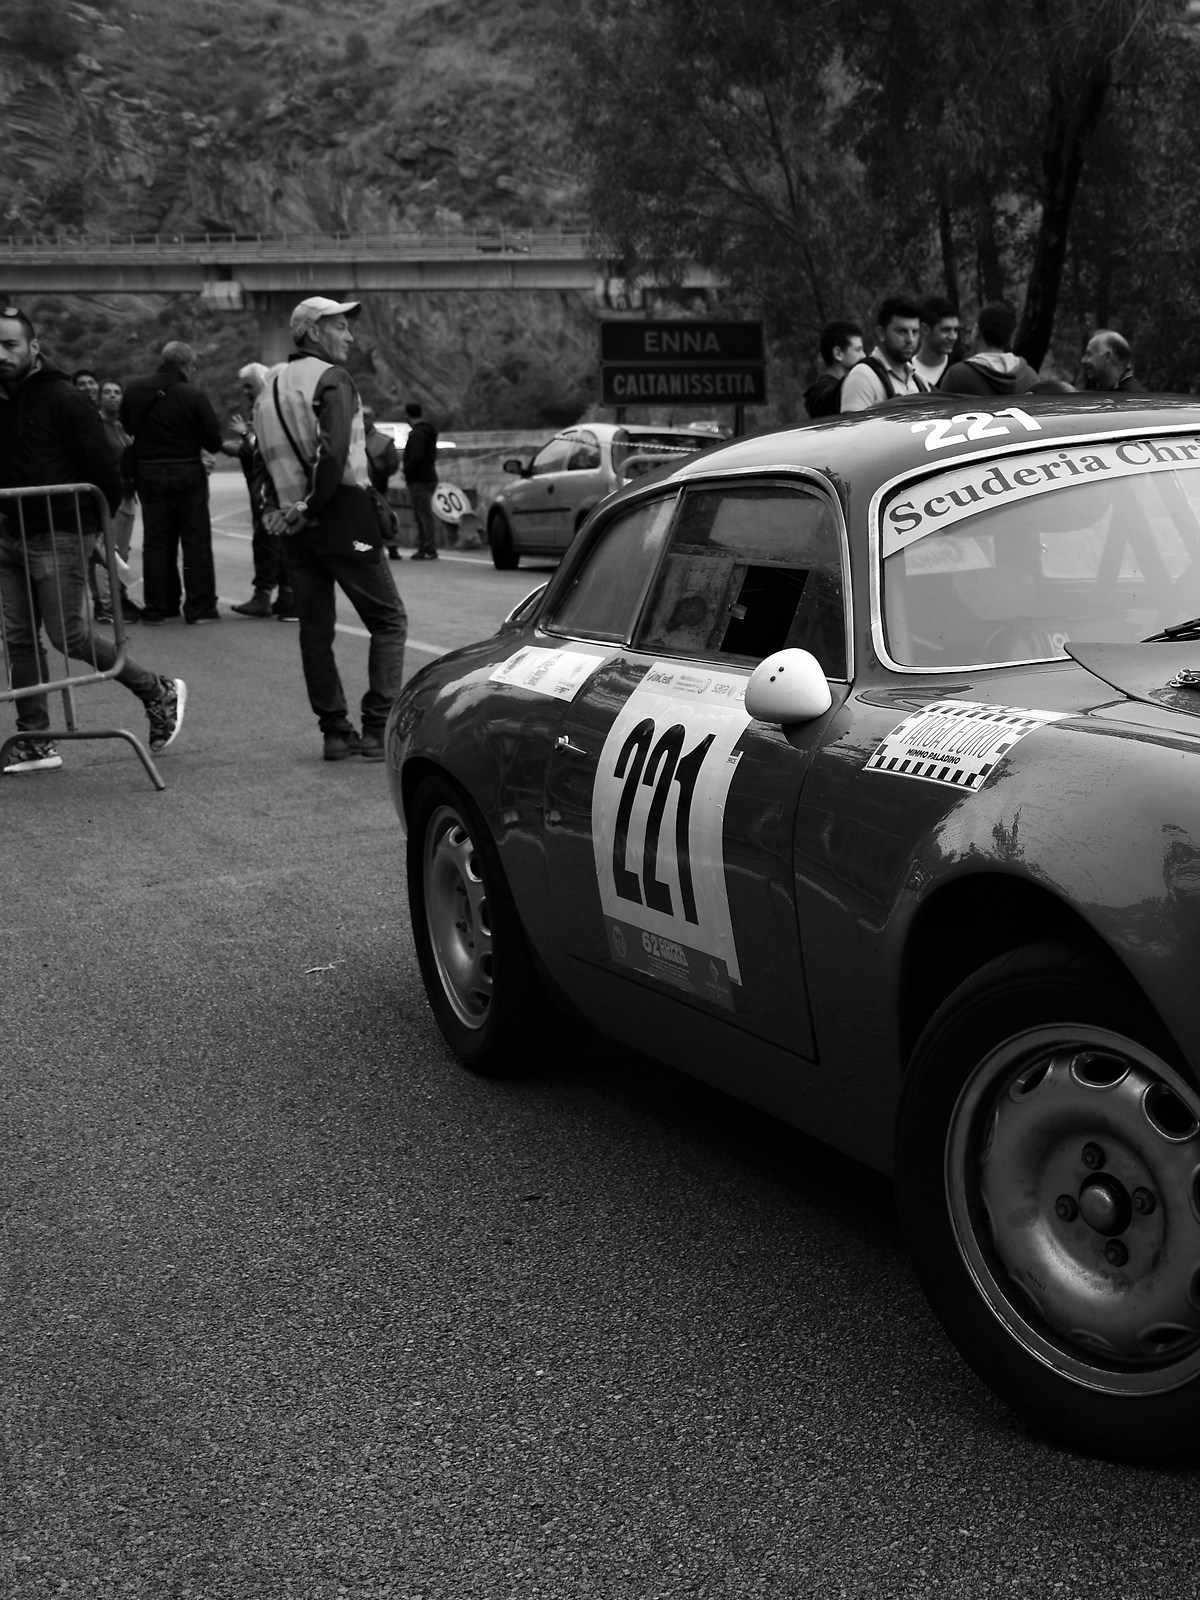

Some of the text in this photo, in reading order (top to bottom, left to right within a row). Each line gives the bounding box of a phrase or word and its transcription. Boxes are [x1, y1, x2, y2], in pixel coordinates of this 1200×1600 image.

[644, 331, 720, 351] ENNA
[613, 373, 756, 395] CALTANISSETTA
[910, 407, 1042, 452] 221
[437, 492, 463, 513] 30
[887, 453, 1111, 535] Scuderia
[899, 714, 1013, 759] TARGA FLORIO
[905, 748, 962, 765] MIMMO PALADINO
[613, 717, 716, 926] 221
